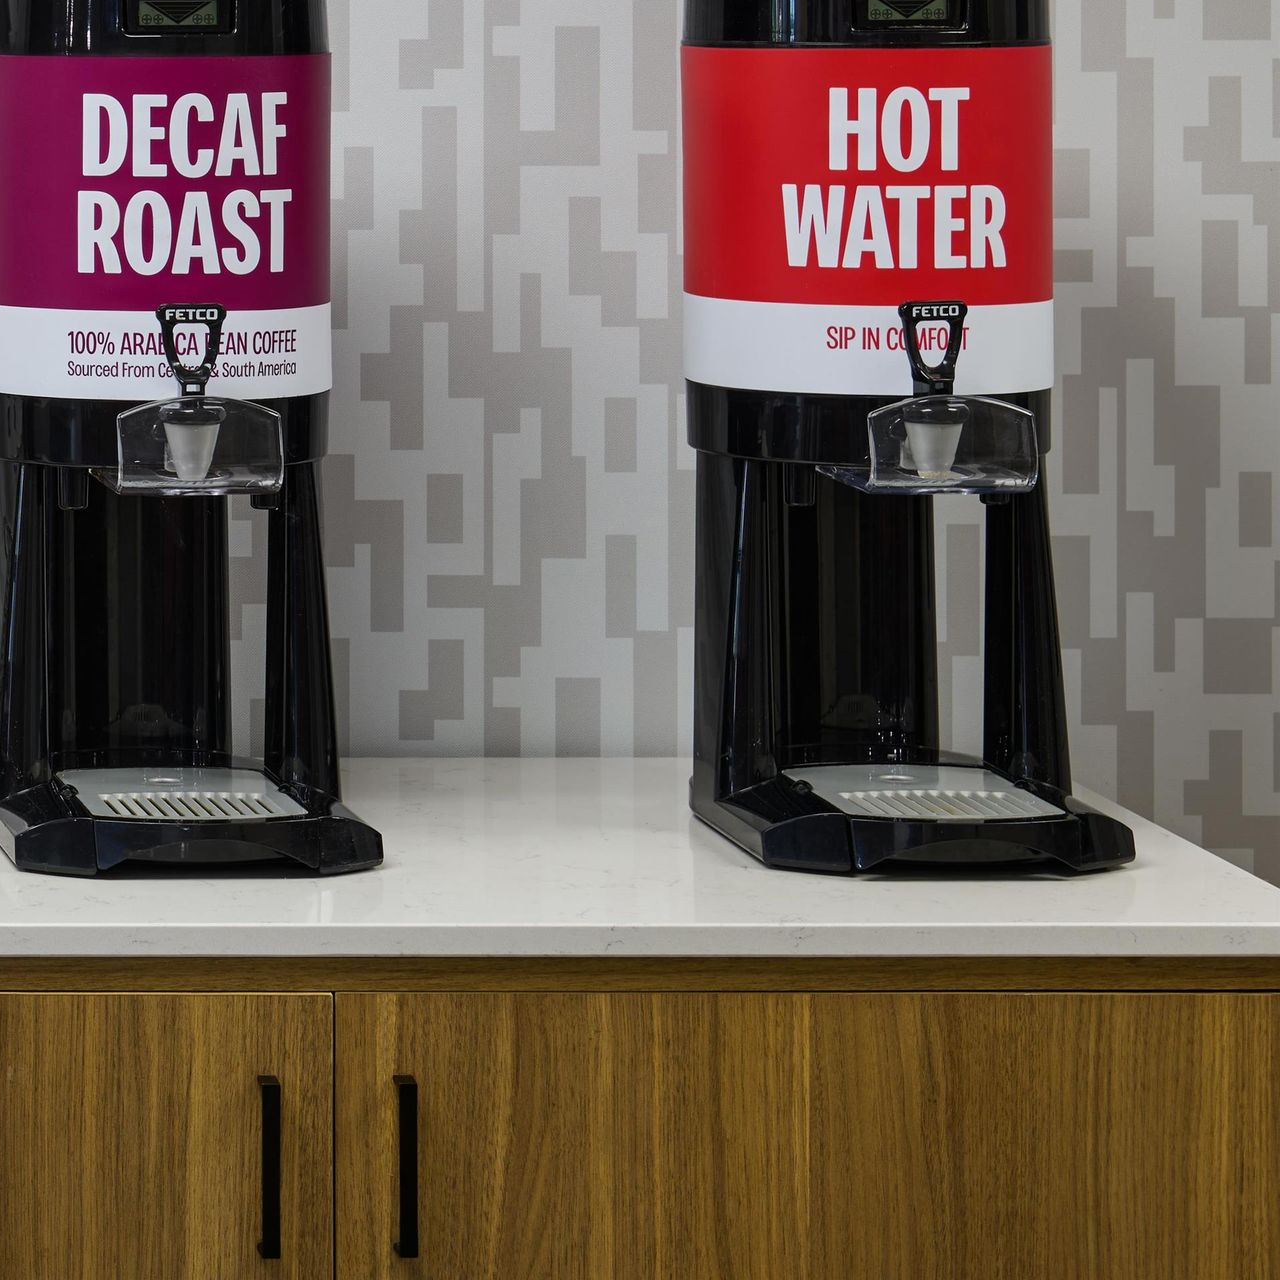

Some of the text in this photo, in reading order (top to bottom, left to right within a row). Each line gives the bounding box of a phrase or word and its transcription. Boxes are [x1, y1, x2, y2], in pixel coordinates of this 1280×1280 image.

[82, 92, 287, 178] DECAF
[828, 86, 970, 173] HOT
[77, 188, 293, 276] ROAST
[781, 183, 1007, 269] WATER
[165, 308, 218, 321] FETCO
[912, 305, 960, 318] FETCO
[67, 330, 115, 355] 100%
[120, 332, 199, 356] ARACA
[252, 329, 297, 355] COFFEE
[826, 326, 970, 351] SIP IN COMFOT
[67, 360, 119, 378] Sourced
[122, 362, 155, 378] From
[221, 361, 256, 378] South
[257, 359, 297, 377] America
